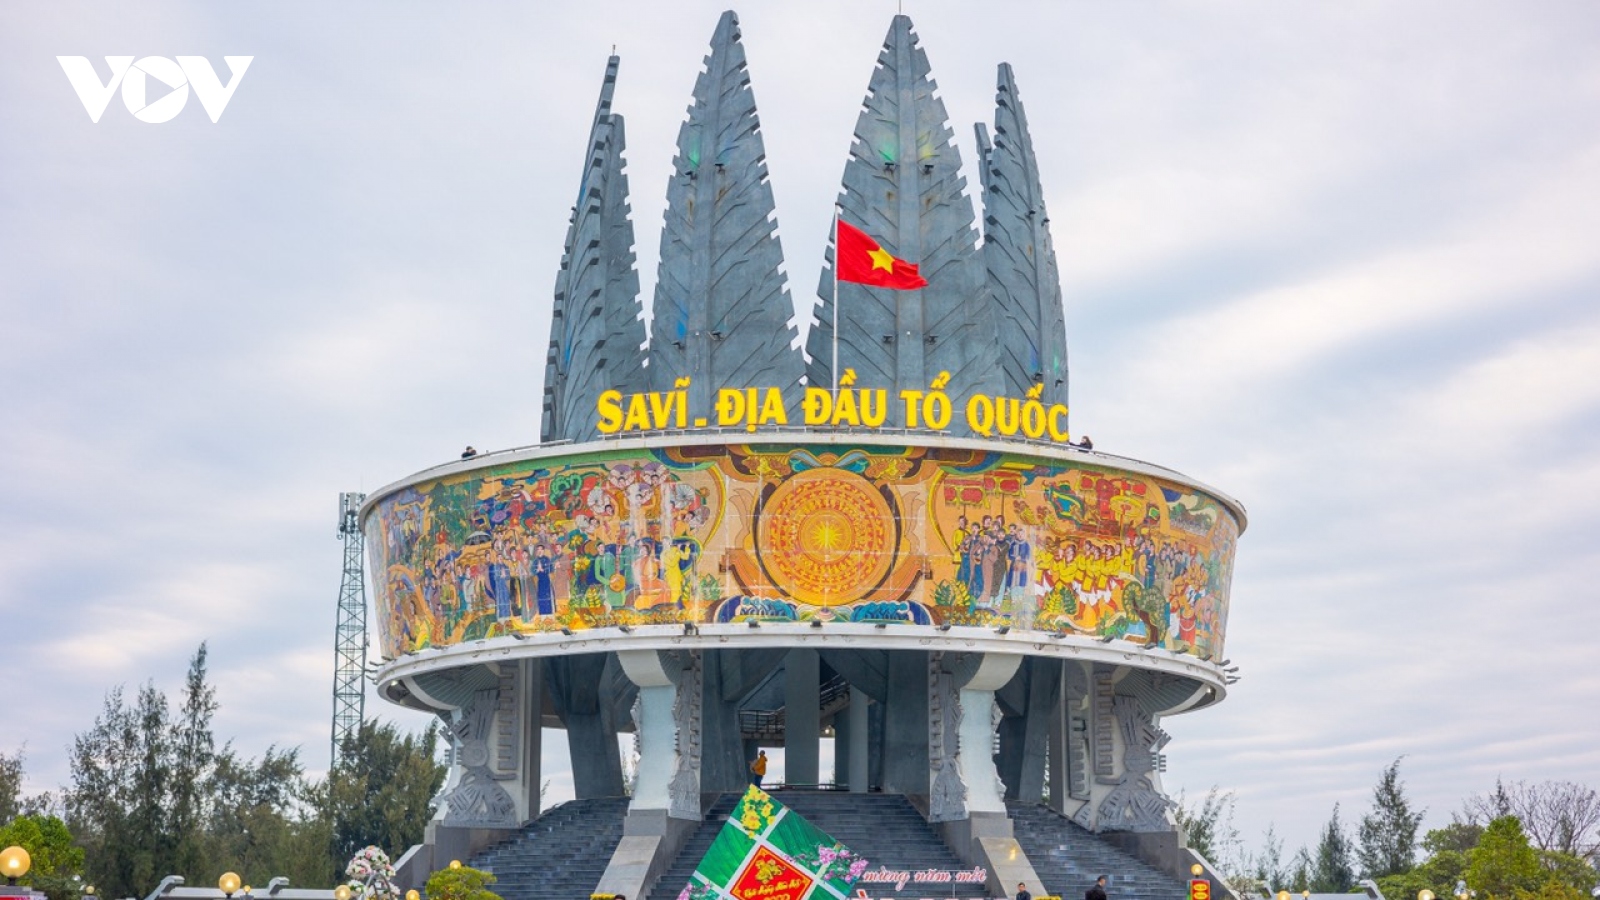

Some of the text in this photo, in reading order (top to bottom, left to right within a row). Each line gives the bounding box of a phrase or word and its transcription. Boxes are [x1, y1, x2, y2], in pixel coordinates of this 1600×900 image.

[597, 375, 690, 434] SAVĨ
[715, 387, 788, 433] ĐỊA
[802, 368, 887, 427] ĐẦU
[900, 371, 953, 431] TỔ
[965, 383, 1070, 443] QUỐC
